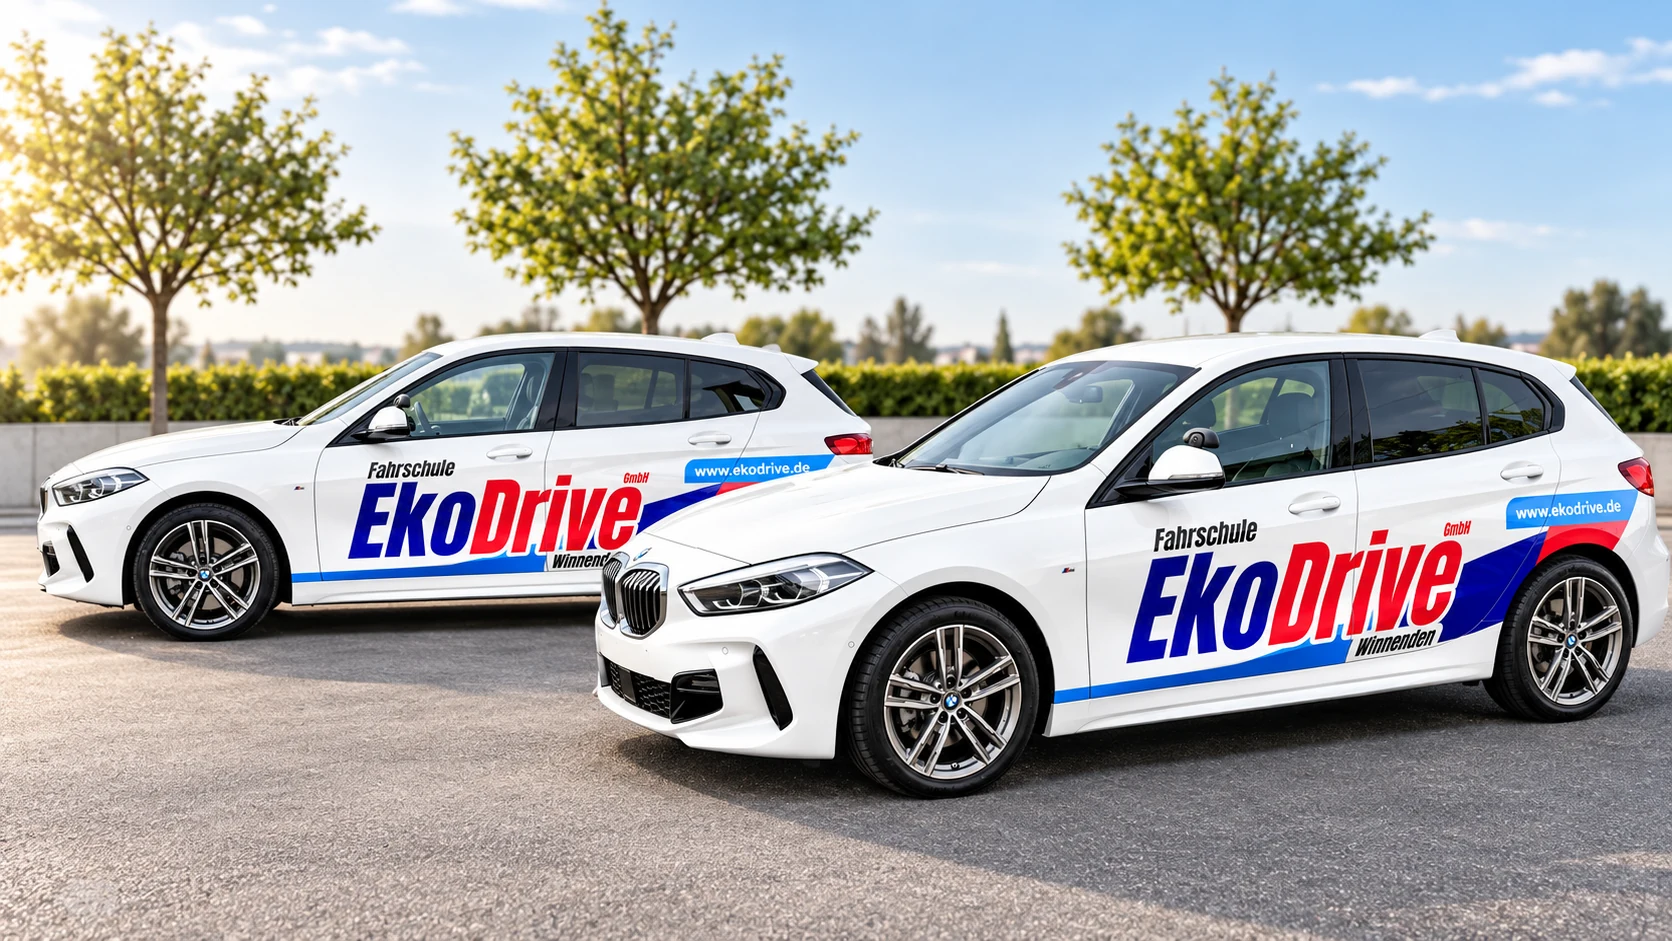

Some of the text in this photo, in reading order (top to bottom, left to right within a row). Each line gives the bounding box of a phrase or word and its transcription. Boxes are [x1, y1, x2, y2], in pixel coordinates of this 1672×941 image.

[367, 460, 455, 479] Fahrschule
[623, 472, 650, 484] GmbH
[695, 462, 810, 476] www.ekodrive.de
[348, 475, 643, 559] EkoDrive
[1516, 500, 1622, 519] www.ekodrive.de
[1153, 519, 1258, 552] Fahrschule
[1443, 520, 1471, 537] GmbH
[552, 552, 611, 568] Winnend
[1126, 529, 1463, 663] EkoDrive
[1355, 630, 1436, 657] Winnenden
